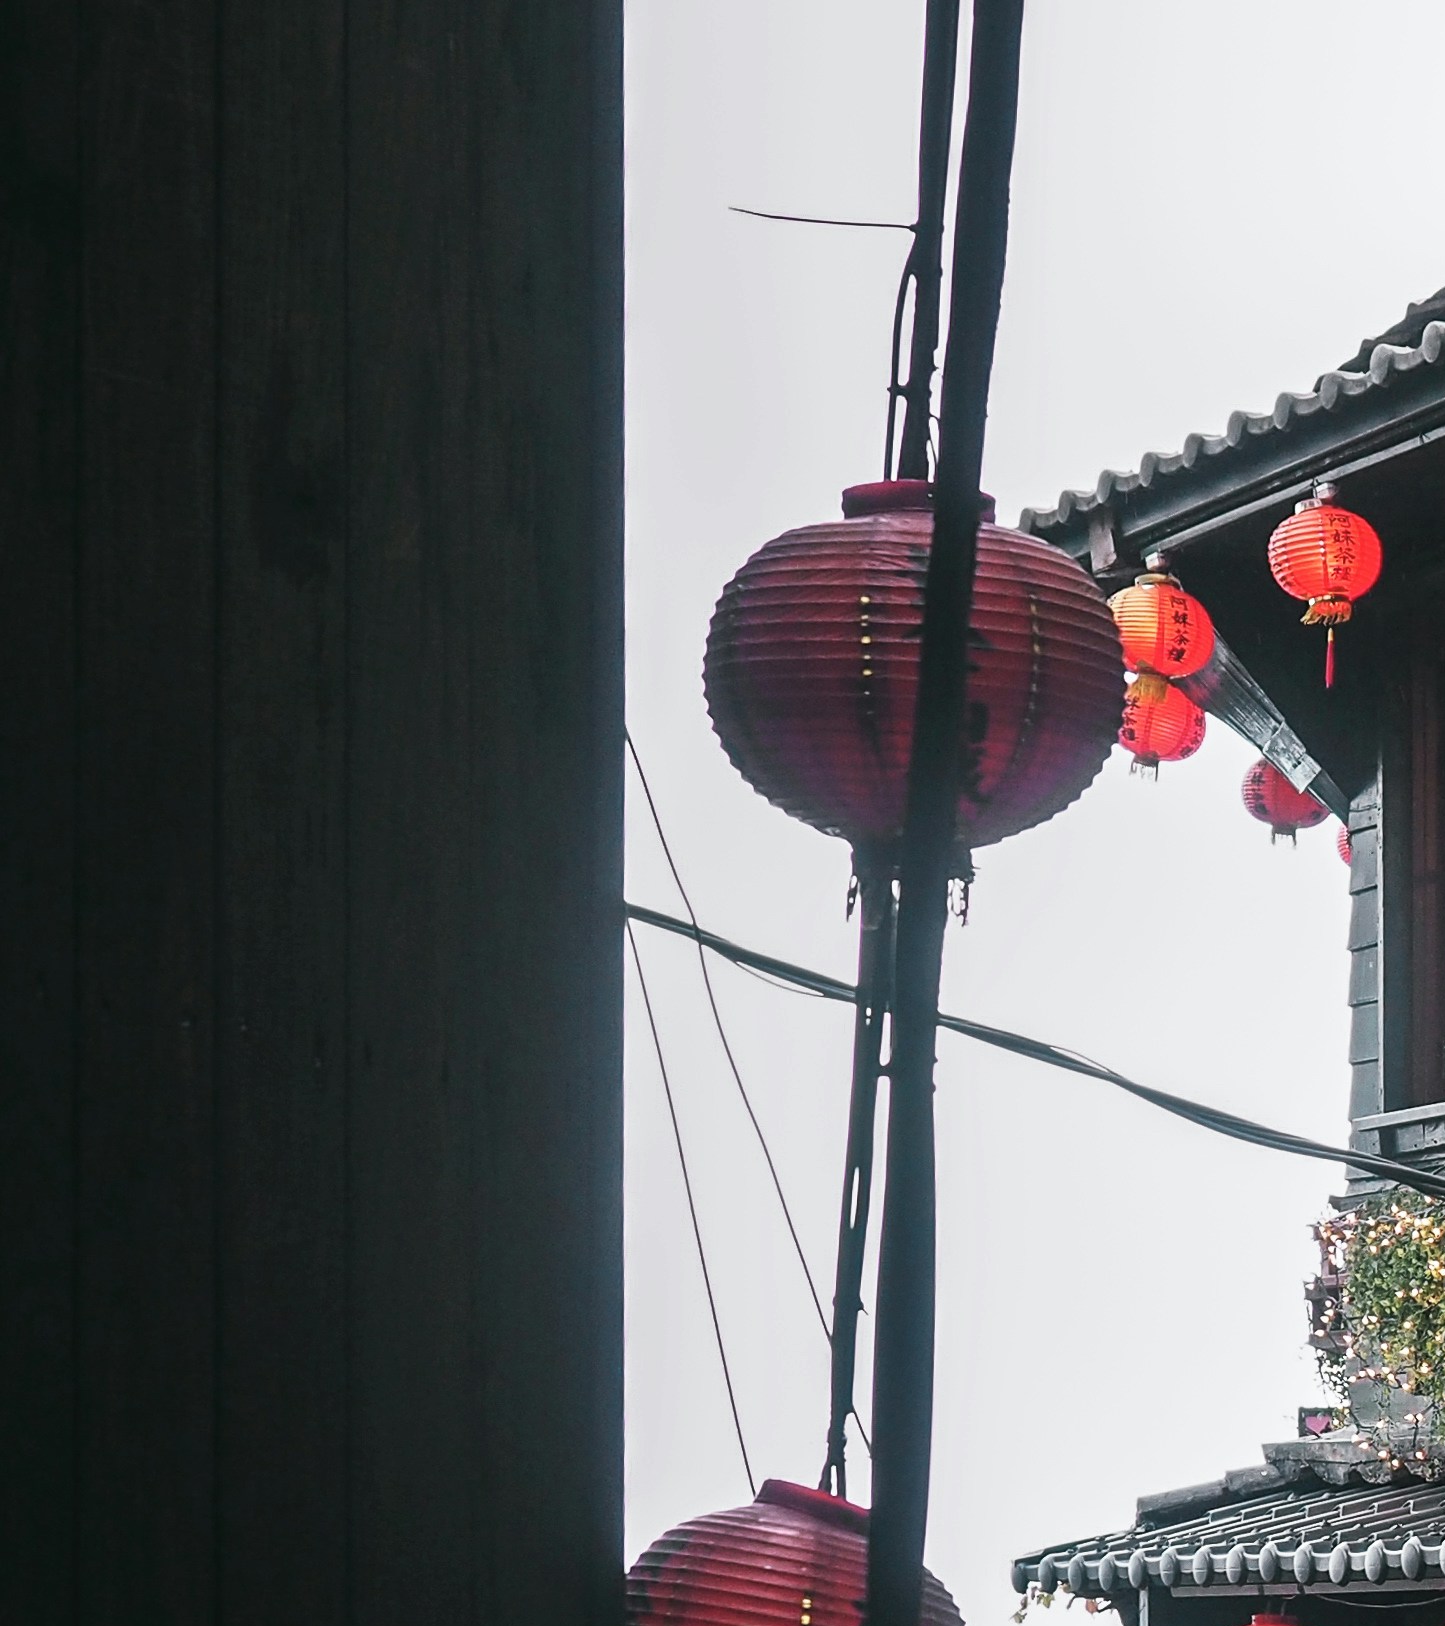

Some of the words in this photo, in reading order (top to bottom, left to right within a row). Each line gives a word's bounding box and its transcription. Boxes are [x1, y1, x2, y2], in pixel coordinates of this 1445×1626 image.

[1326, 512, 1357, 581] 阿妹茶樓
[1167, 594, 1194, 663] 阿妹茶樓
